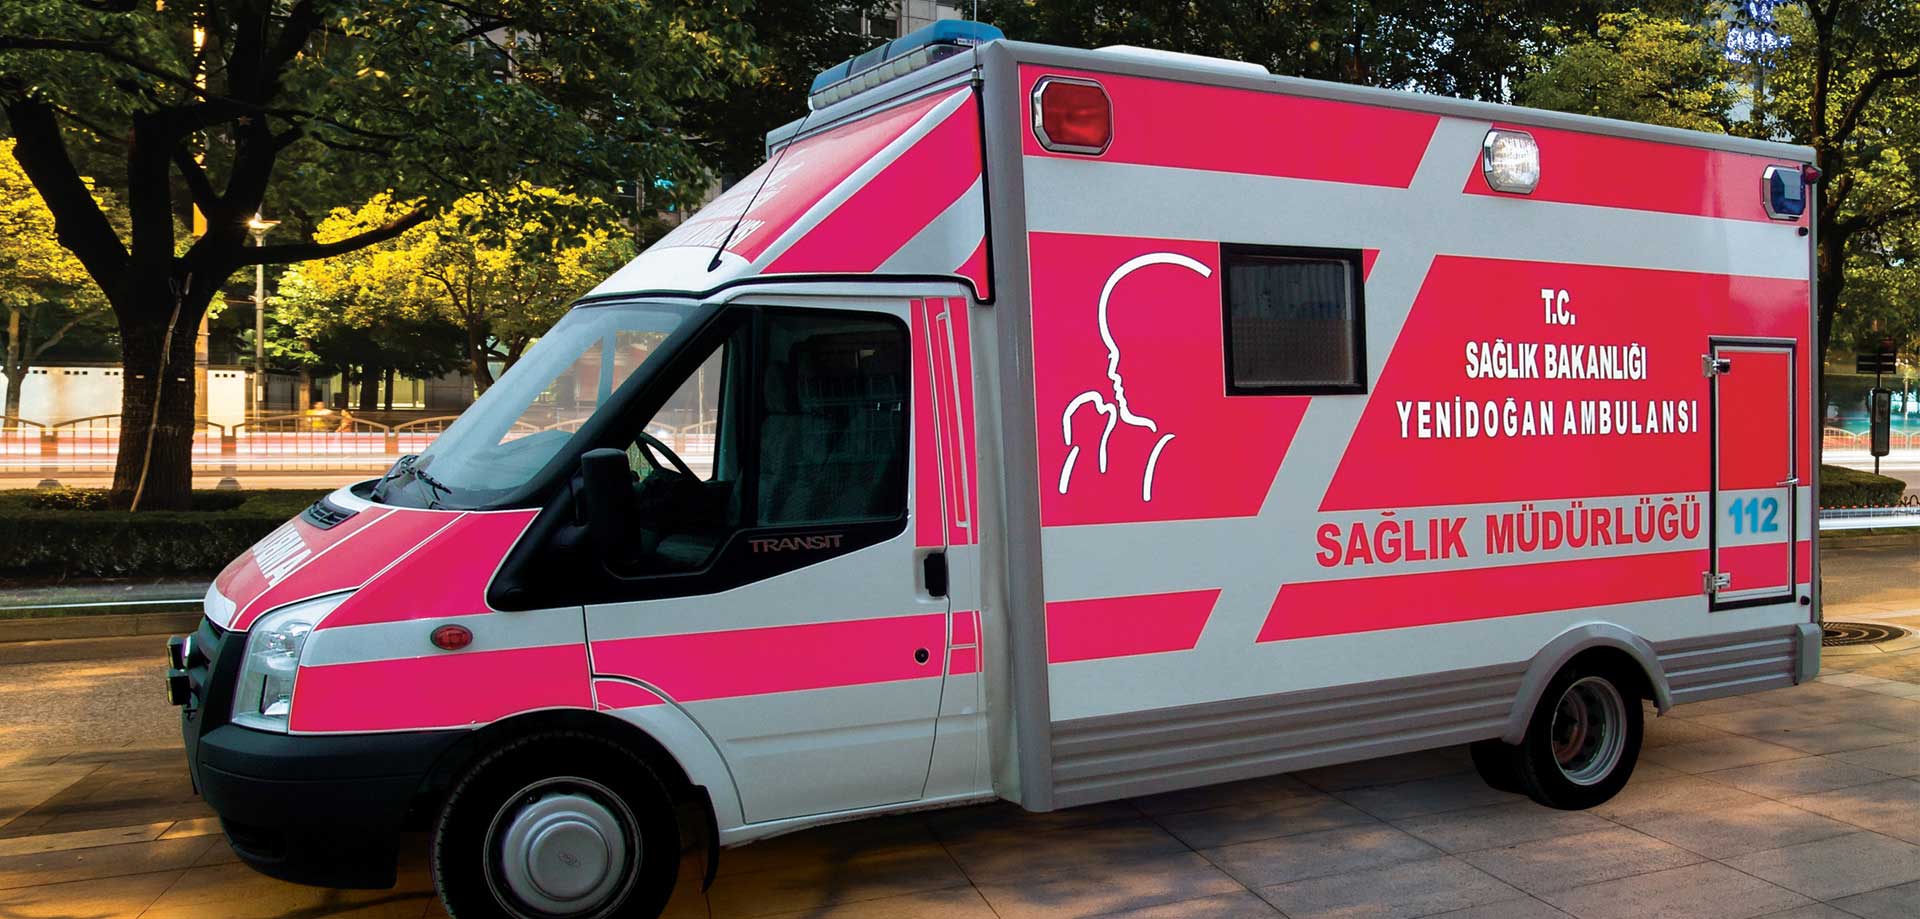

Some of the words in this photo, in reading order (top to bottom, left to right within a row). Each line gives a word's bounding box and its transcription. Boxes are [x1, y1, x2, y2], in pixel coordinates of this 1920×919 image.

[1541, 288, 1576, 326] T.C.
[1465, 338, 1539, 379] SAĞLIK
[1544, 342, 1647, 380] BAKANLIĞI
[1395, 396, 1554, 438] YENİDOĞAN
[1562, 399, 1697, 435] AMBULANSI
[1316, 511, 1468, 567] SAĞLIK
[1485, 495, 1701, 555] MÜDÜRLÜĞÜ
[1728, 496, 1779, 535] 112
[748, 534, 844, 553] TRANSIT
